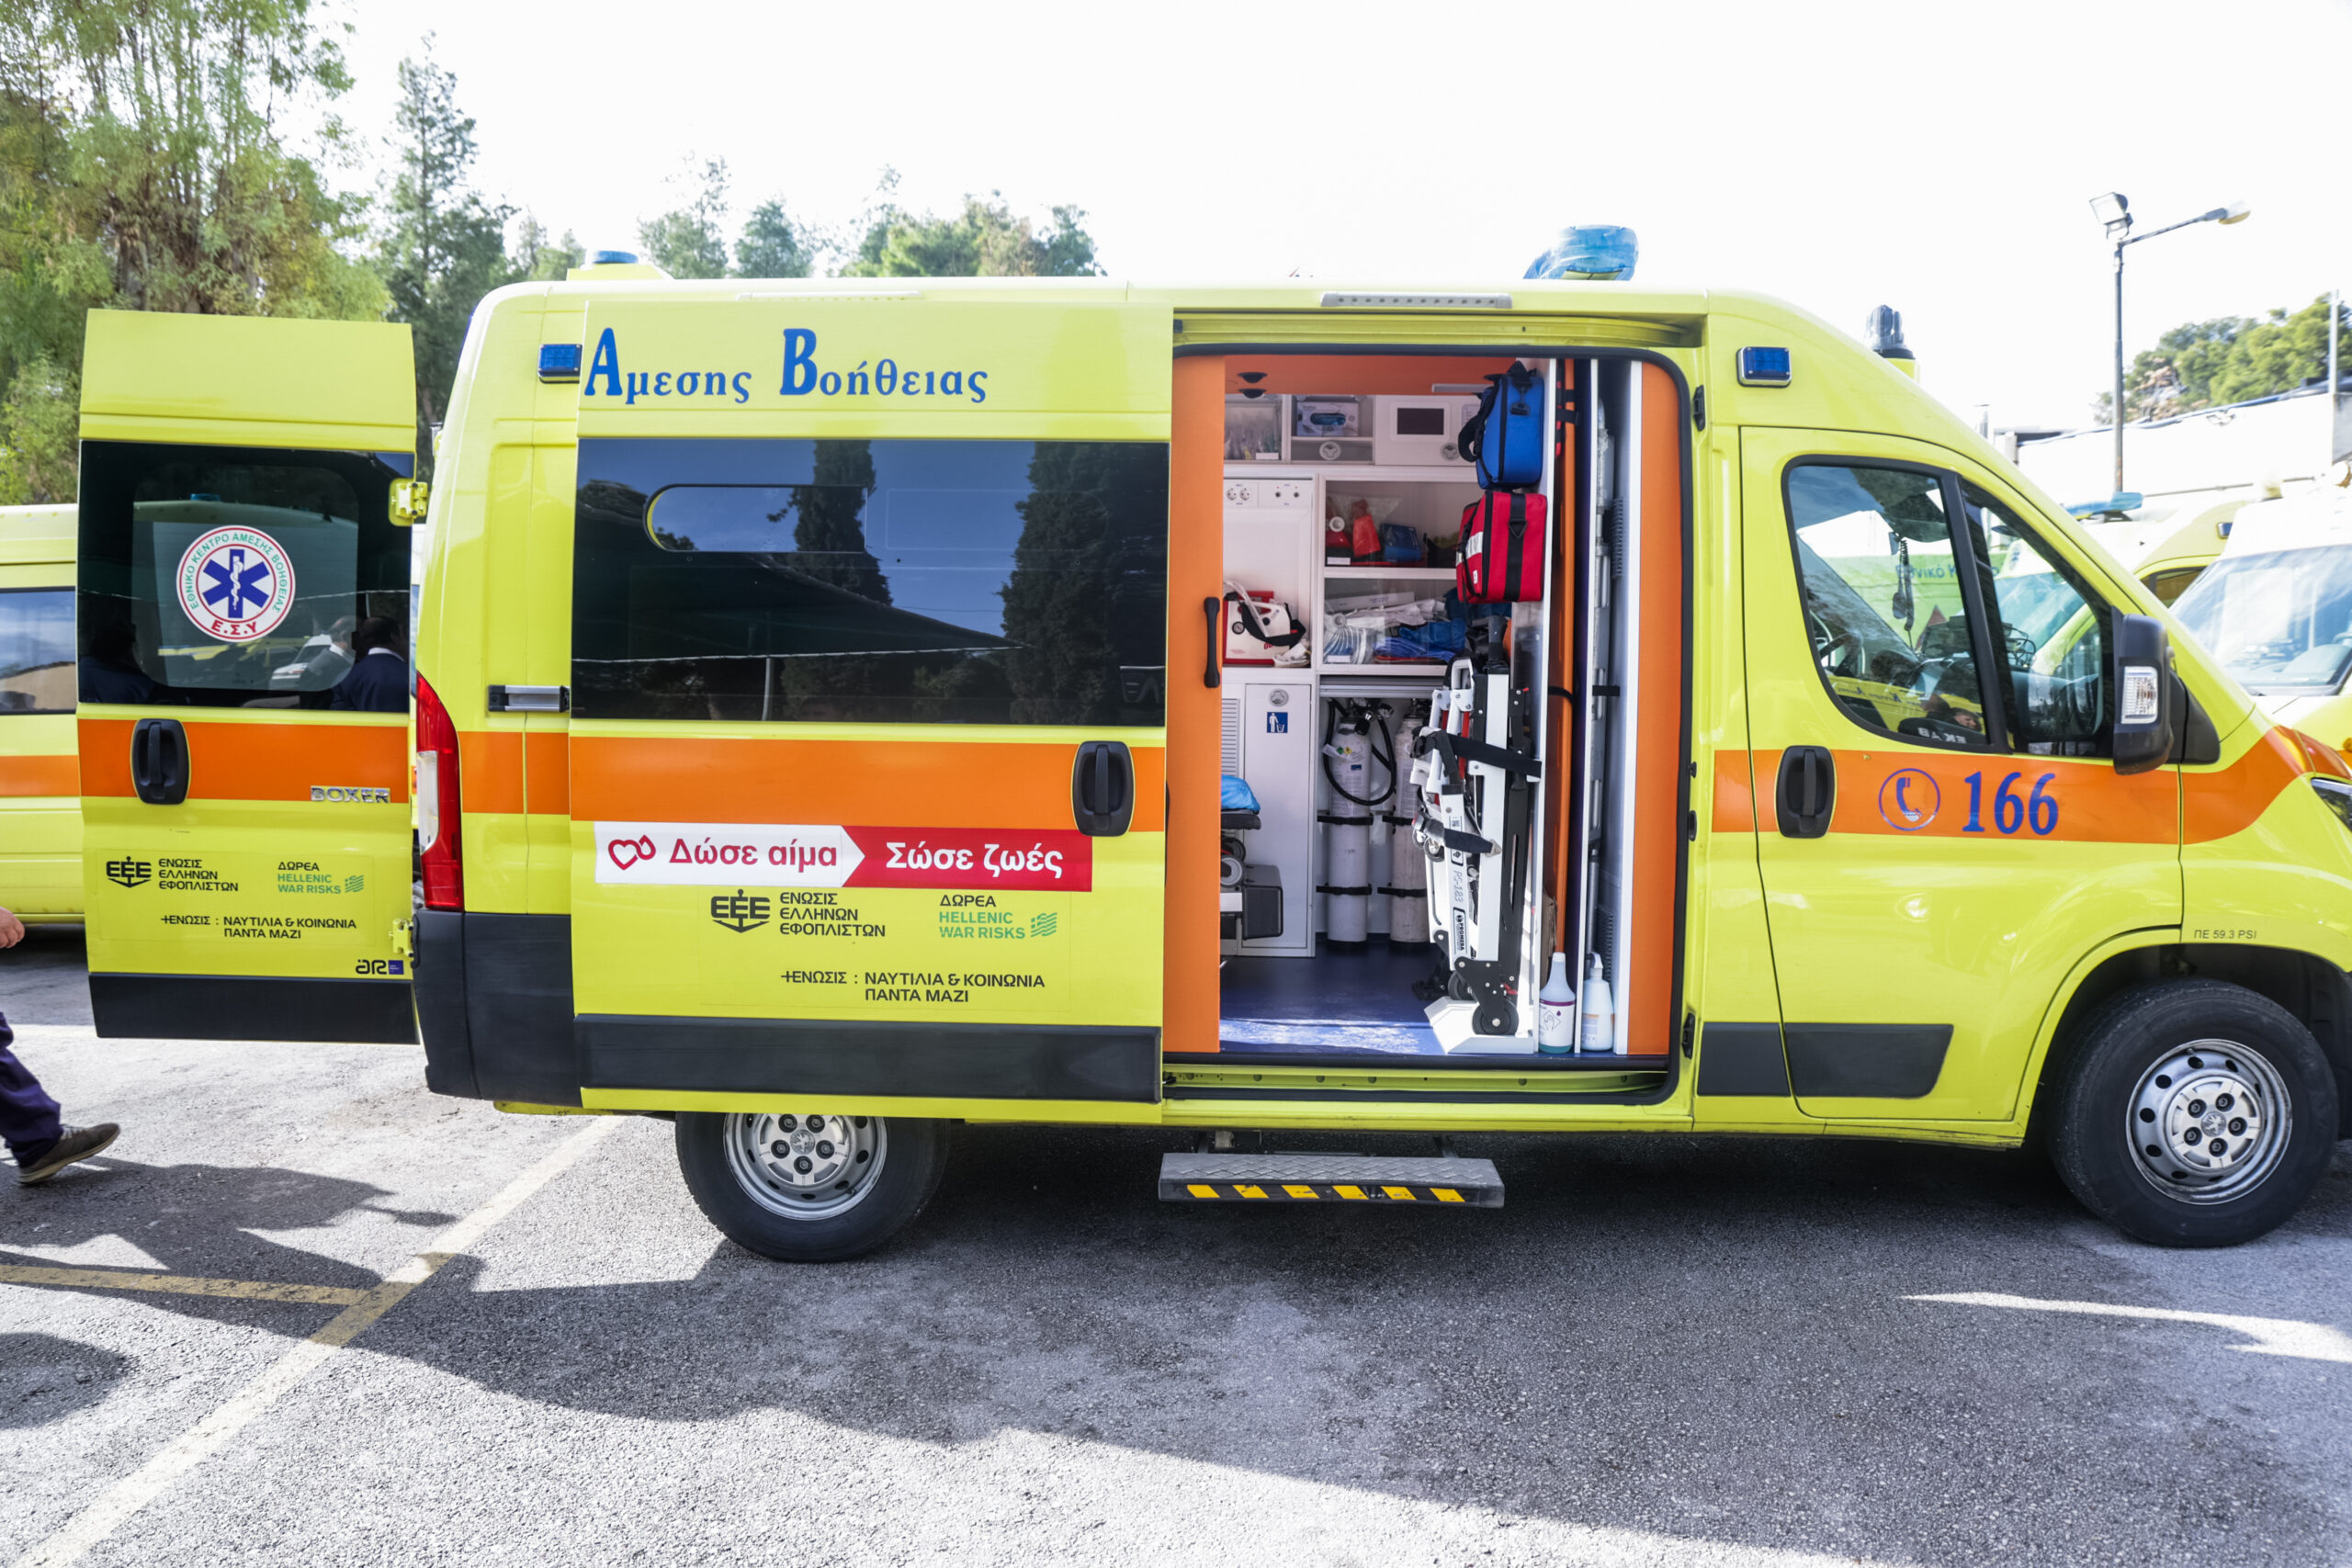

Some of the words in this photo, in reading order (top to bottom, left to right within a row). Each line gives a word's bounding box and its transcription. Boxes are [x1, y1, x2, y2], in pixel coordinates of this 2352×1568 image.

[584, 327, 752, 404] Αμεσης
[779, 328, 989, 403] Βοήθειας
[185, 565, 199, 609] ΕΘΝΙΚΟ
[192, 534, 230, 563] ΚΕΝΤΡΟ
[232, 533, 274, 556] ΑΜΕΣΗΣ
[270, 554, 288, 613] ΒΟΗΘΕΙΑΣ
[311, 786, 390, 804] BOXER
[1962, 771, 2059, 836] 166
[669, 837, 758, 865] Δώσε
[768, 839, 837, 873] αίμα
[886, 840, 974, 870] Σώσε
[983, 842, 1064, 879] ζωές
[158, 858, 203, 869] ΕΝΩΣΙΣ
[277, 861, 320, 872] ΔΩΡΕΑ
[158, 870, 219, 880] ΕΛΛΗΝΩΝ
[277, 874, 333, 884] HELLENIC
[158, 880, 239, 892] ΕΦΟΠΛΙΣΤΩΝ
[277, 884, 304, 893] WAR
[307, 885, 342, 894] RISKS
[779, 892, 838, 906] ΕΝΩΣΙΣ
[940, 894, 997, 908] ΔΩΡΕΑ
[779, 908, 858, 921] ΕΛΛΗΝΩΝ
[939, 911, 1013, 924] HELLENIC
[223, 916, 284, 927] ΝΑΥΤΙΛΙΑ
[285, 918, 295, 927] &
[297, 918, 357, 929] ΚΟΙΝΩΝΙΑ
[779, 922, 886, 937] ΕΦΟΠΛΙΣΤΩΝ
[224, 928, 266, 938] ΠΑΝΤΑ
[269, 929, 301, 940] ΜΑΖΙ
[939, 926, 975, 939] WAR
[978, 927, 1025, 940] RISKS
[2213, 930, 2235, 940] 59.3
[2238, 930, 2257, 940] PSI
[865, 972, 944, 986] ΝΑΥΤΙΛΙΑ
[947, 973, 961, 987] &
[964, 974, 1046, 987] ΚΟΙΝΩΝΙΑ
[865, 988, 922, 1001] ΠΑΝΤΑ
[925, 989, 969, 1002] ΜΑΖΙ
